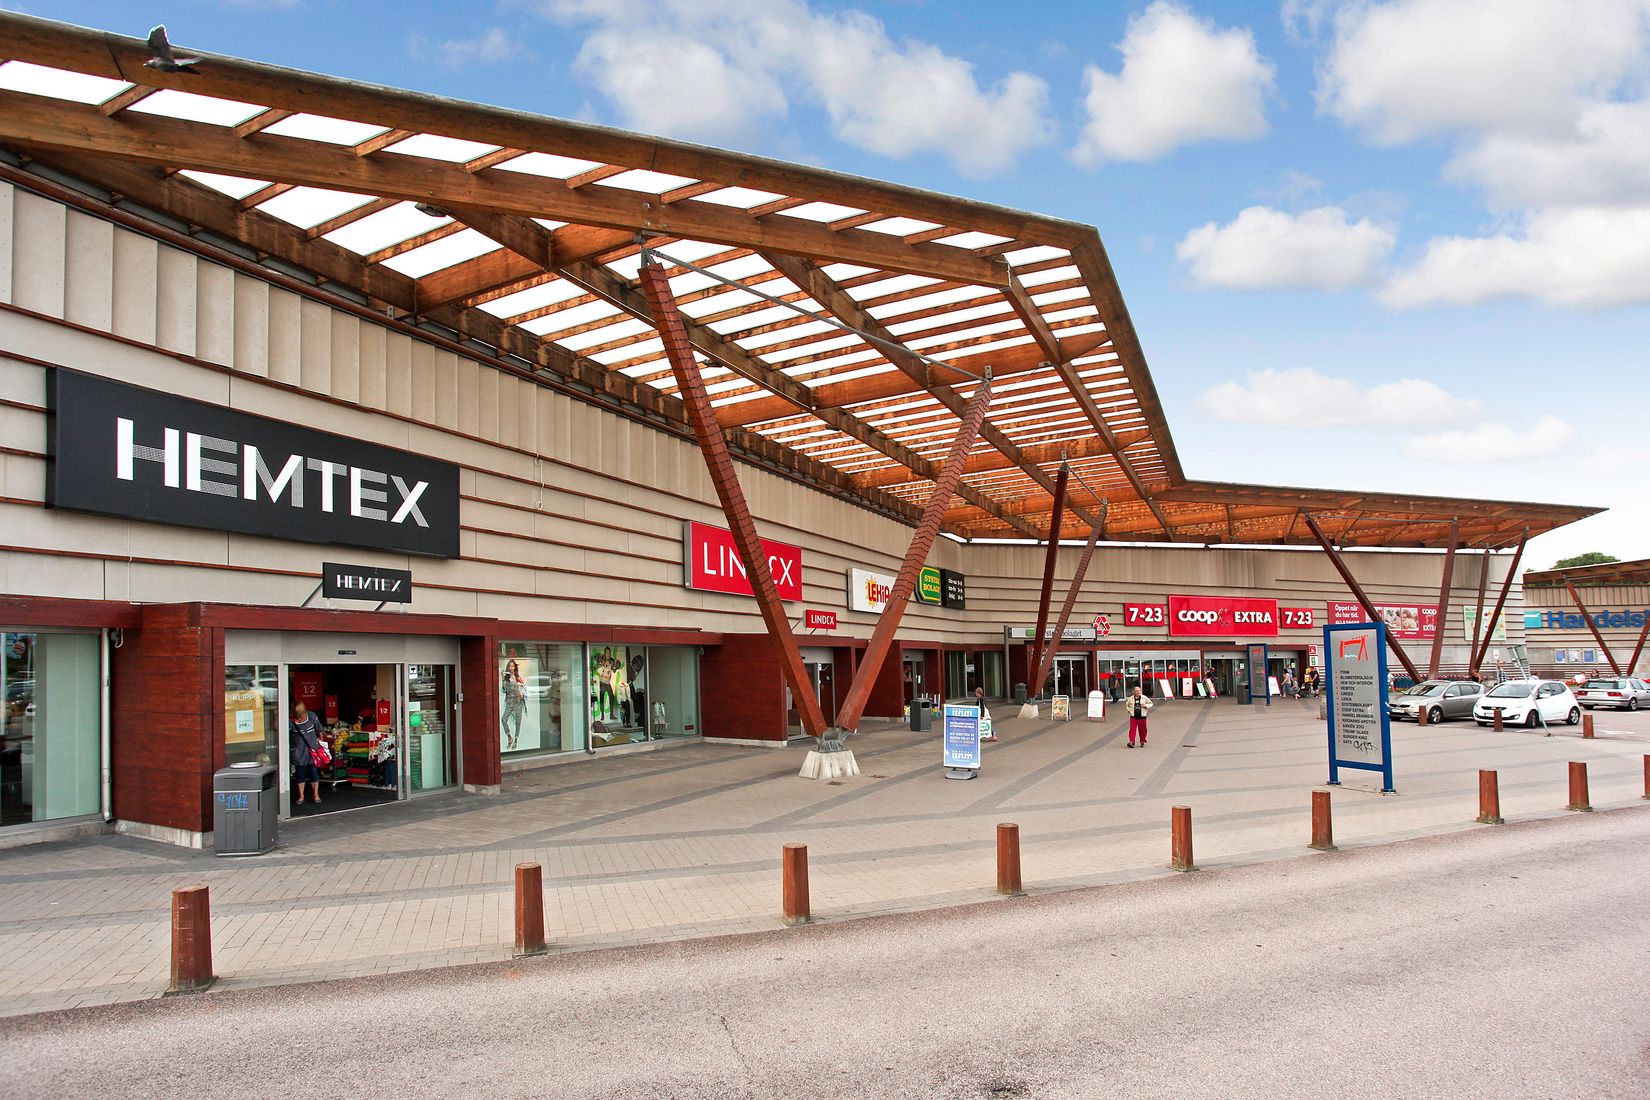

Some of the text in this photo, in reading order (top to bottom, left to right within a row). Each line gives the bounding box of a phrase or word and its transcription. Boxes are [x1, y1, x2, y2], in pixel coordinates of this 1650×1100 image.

[116, 416, 430, 528] HEMTEX
[703, 541, 794, 587] LINEX
[336, 574, 401, 592] HEMTEX
[810, 614, 835, 625] LINDEX
[1129, 607, 1163, 622] 7-23
[1234, 611, 1273, 624] EXTRA
[1285, 611, 1312, 625] 7-23
